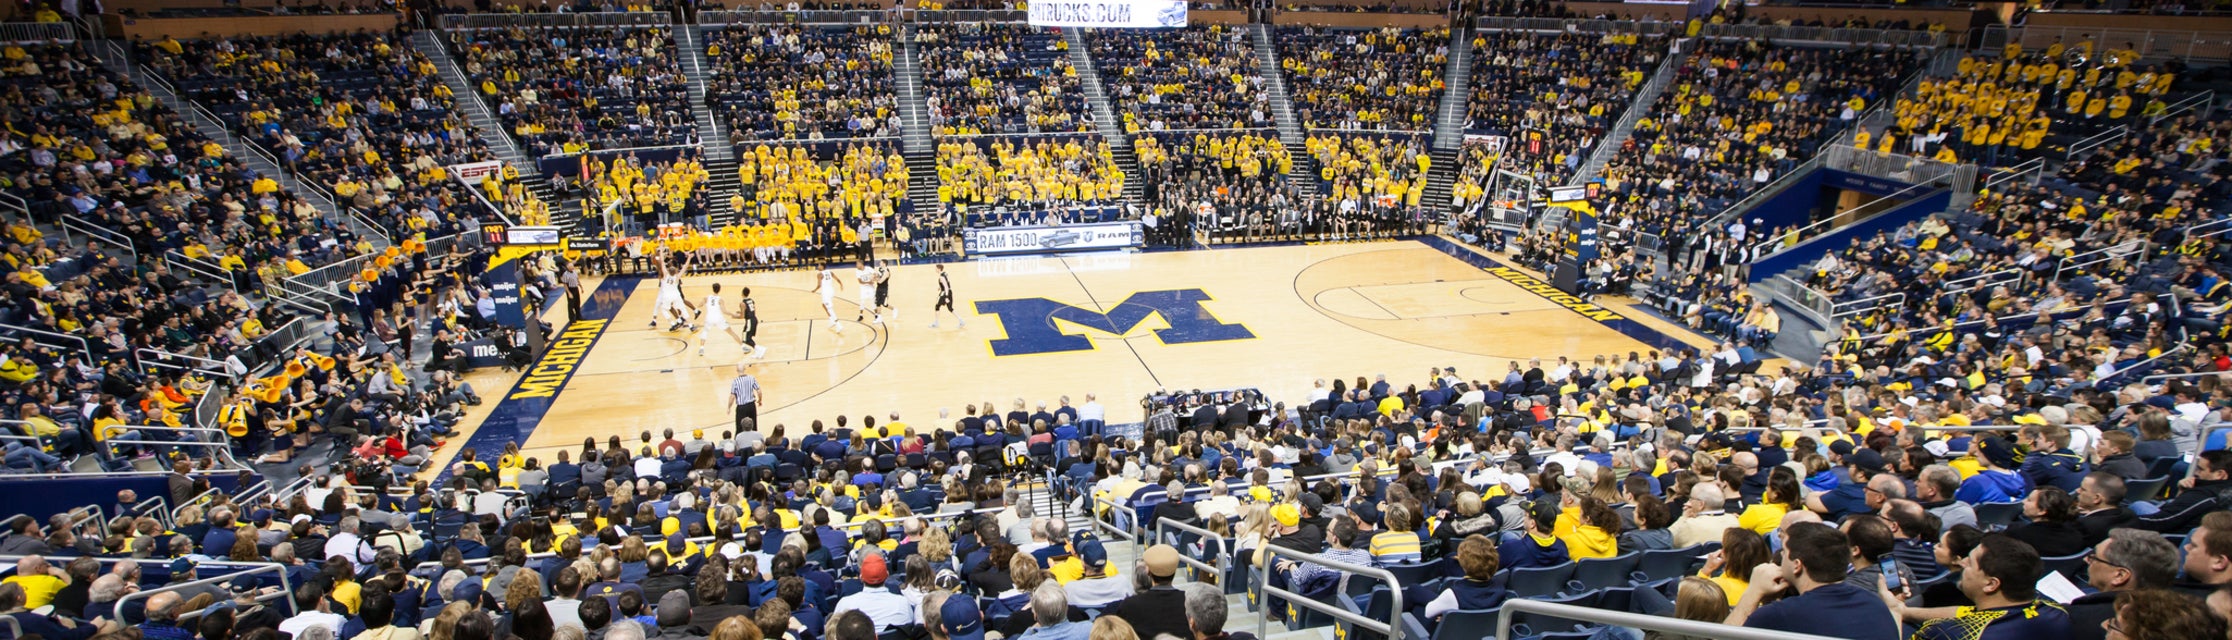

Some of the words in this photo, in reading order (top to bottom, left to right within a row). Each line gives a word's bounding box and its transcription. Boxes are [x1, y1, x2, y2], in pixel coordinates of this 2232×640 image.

[979, 233, 1006, 249] RAM
[1009, 232, 1037, 248] 1500
[1097, 231, 1130, 239] RAM
[493, 281, 517, 292] meijer
[1483, 266, 1625, 321] MICHIGAN
[494, 294, 518, 305] meijer
[969, 288, 1262, 359] M
[509, 318, 609, 400] MICHIGAN
